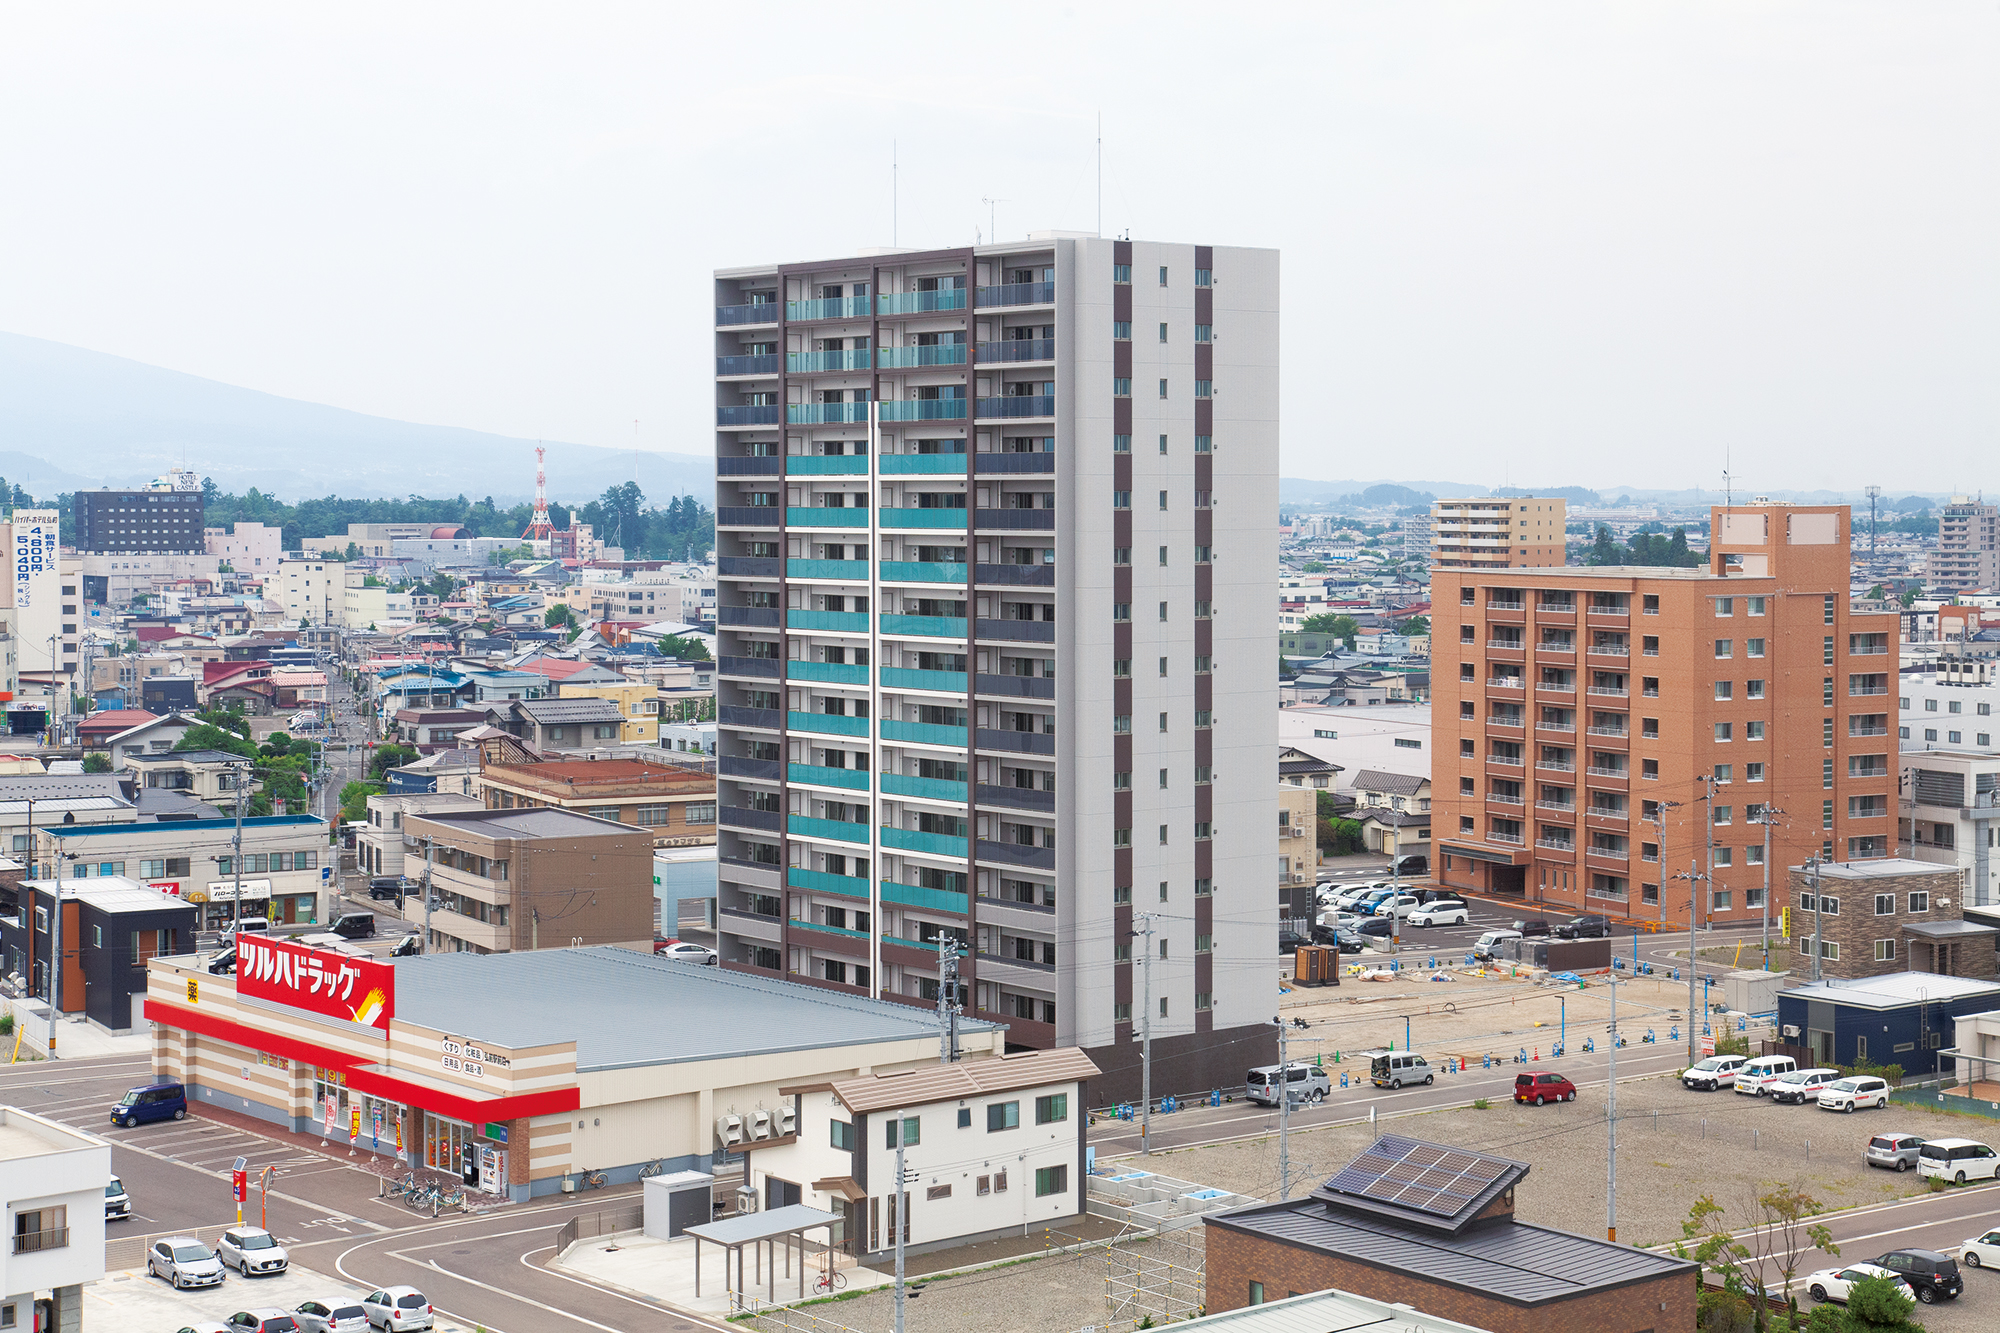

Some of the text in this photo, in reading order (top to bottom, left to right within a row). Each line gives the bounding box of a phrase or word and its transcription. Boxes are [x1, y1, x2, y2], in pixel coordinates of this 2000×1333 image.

[239, 941, 360, 1001] ツルハドラッグ
[187, 981, 197, 1002] 薬
[444, 1042, 458, 1054] くすり
[351, 1112, 360, 1136] 特売日
[299, 1217, 347, 1228] OUT
